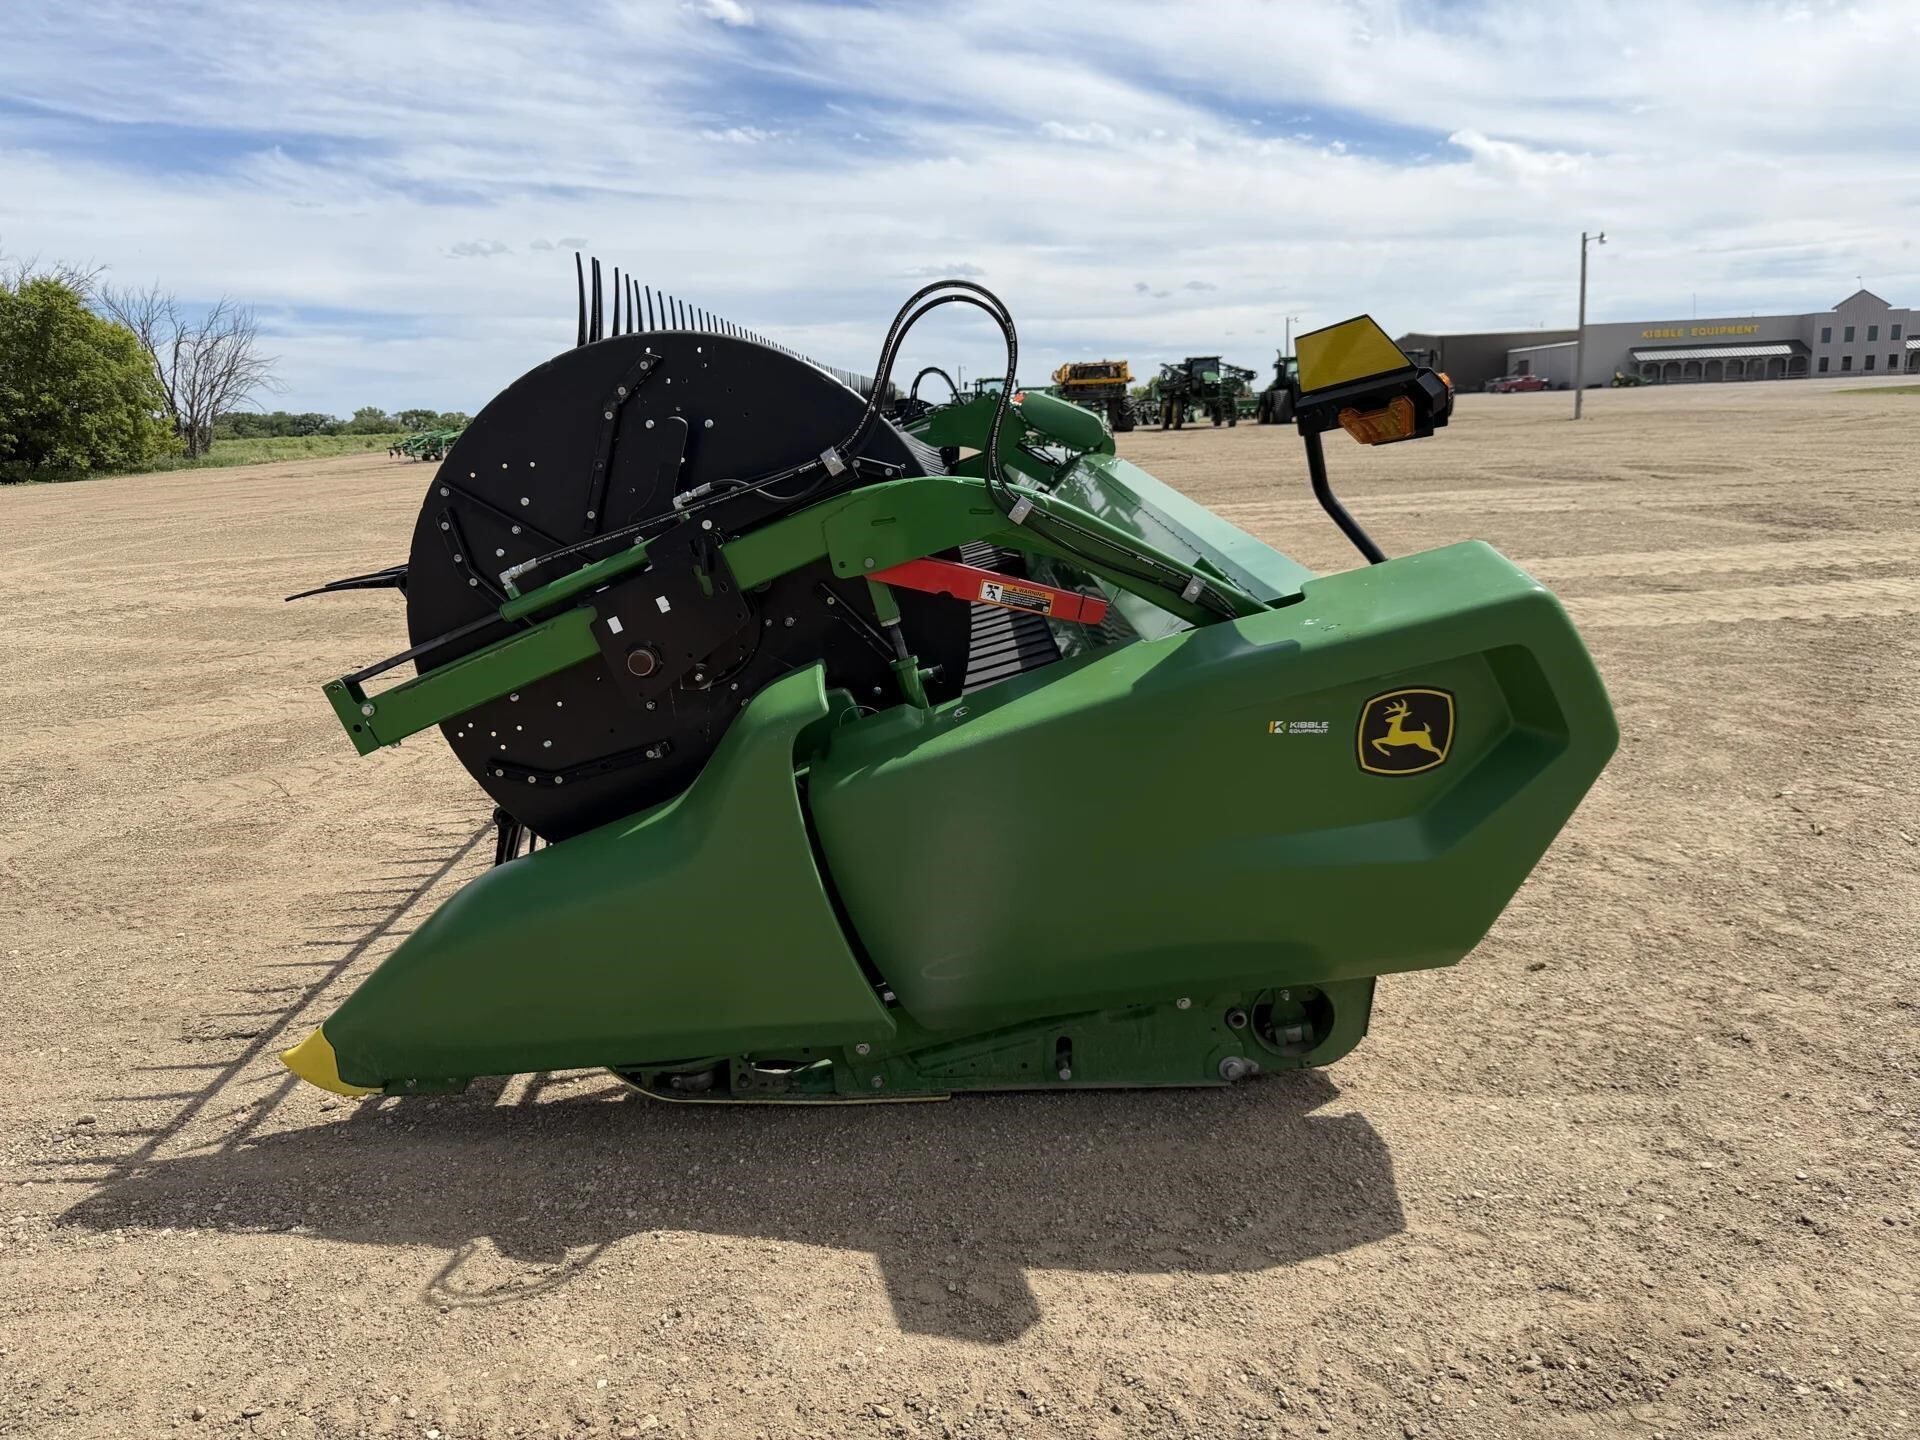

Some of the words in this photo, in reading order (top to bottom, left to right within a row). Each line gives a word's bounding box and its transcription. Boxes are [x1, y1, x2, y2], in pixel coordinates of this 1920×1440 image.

[1642, 328, 1684, 339] KIBBLE
[1690, 325, 1759, 337] EQUIPMENT
[1019, 588, 1046, 597] WARNING
